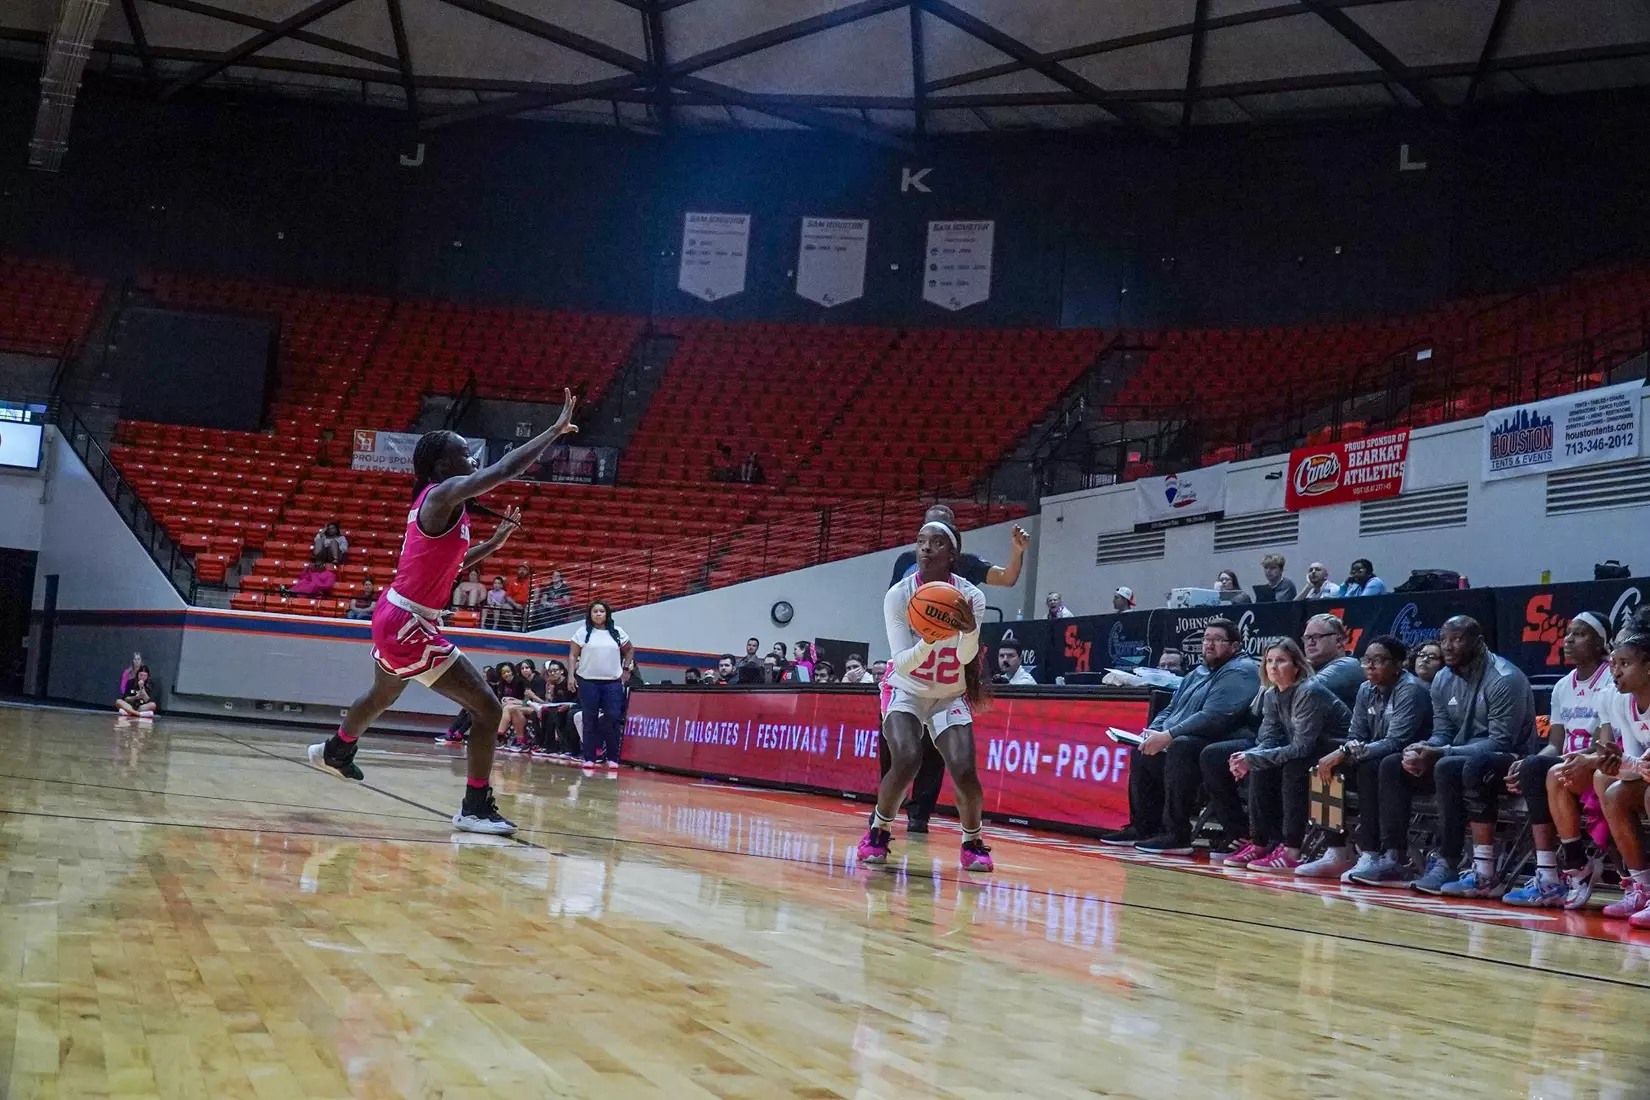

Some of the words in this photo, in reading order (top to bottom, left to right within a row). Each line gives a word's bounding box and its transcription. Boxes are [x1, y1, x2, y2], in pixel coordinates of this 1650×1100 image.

[1399, 144, 1427, 171] L
[901, 167, 933, 193] K
[826, 222, 864, 230] HOUSTON
[953, 223, 990, 232] HOUSTON
[1344, 440, 1365, 452] PROUD
[1366, 434, 1396, 448] SPONSOR
[1397, 432, 1406, 442] OF
[1490, 422, 1554, 460] HOUSTON
[1565, 421, 1634, 441] houstontents.com
[1348, 444, 1403, 468] BEARKAT
[1565, 433, 1634, 457] 713-346-2012
[353, 453, 385, 463] PROUD
[1491, 458, 1513, 469] TENTS
[1514, 457, 1521, 465] &
[1522, 451, 1553, 464] EVENTS
[1343, 460, 1405, 486] ATHLETICS
[910, 647, 961, 684] 22
[637, 716, 670, 739] EVENTS
[683, 719, 740, 746] TAILGATES
[756, 723, 829, 753] FESTIVALS
[987, 738, 1129, 783] NON-PROF
